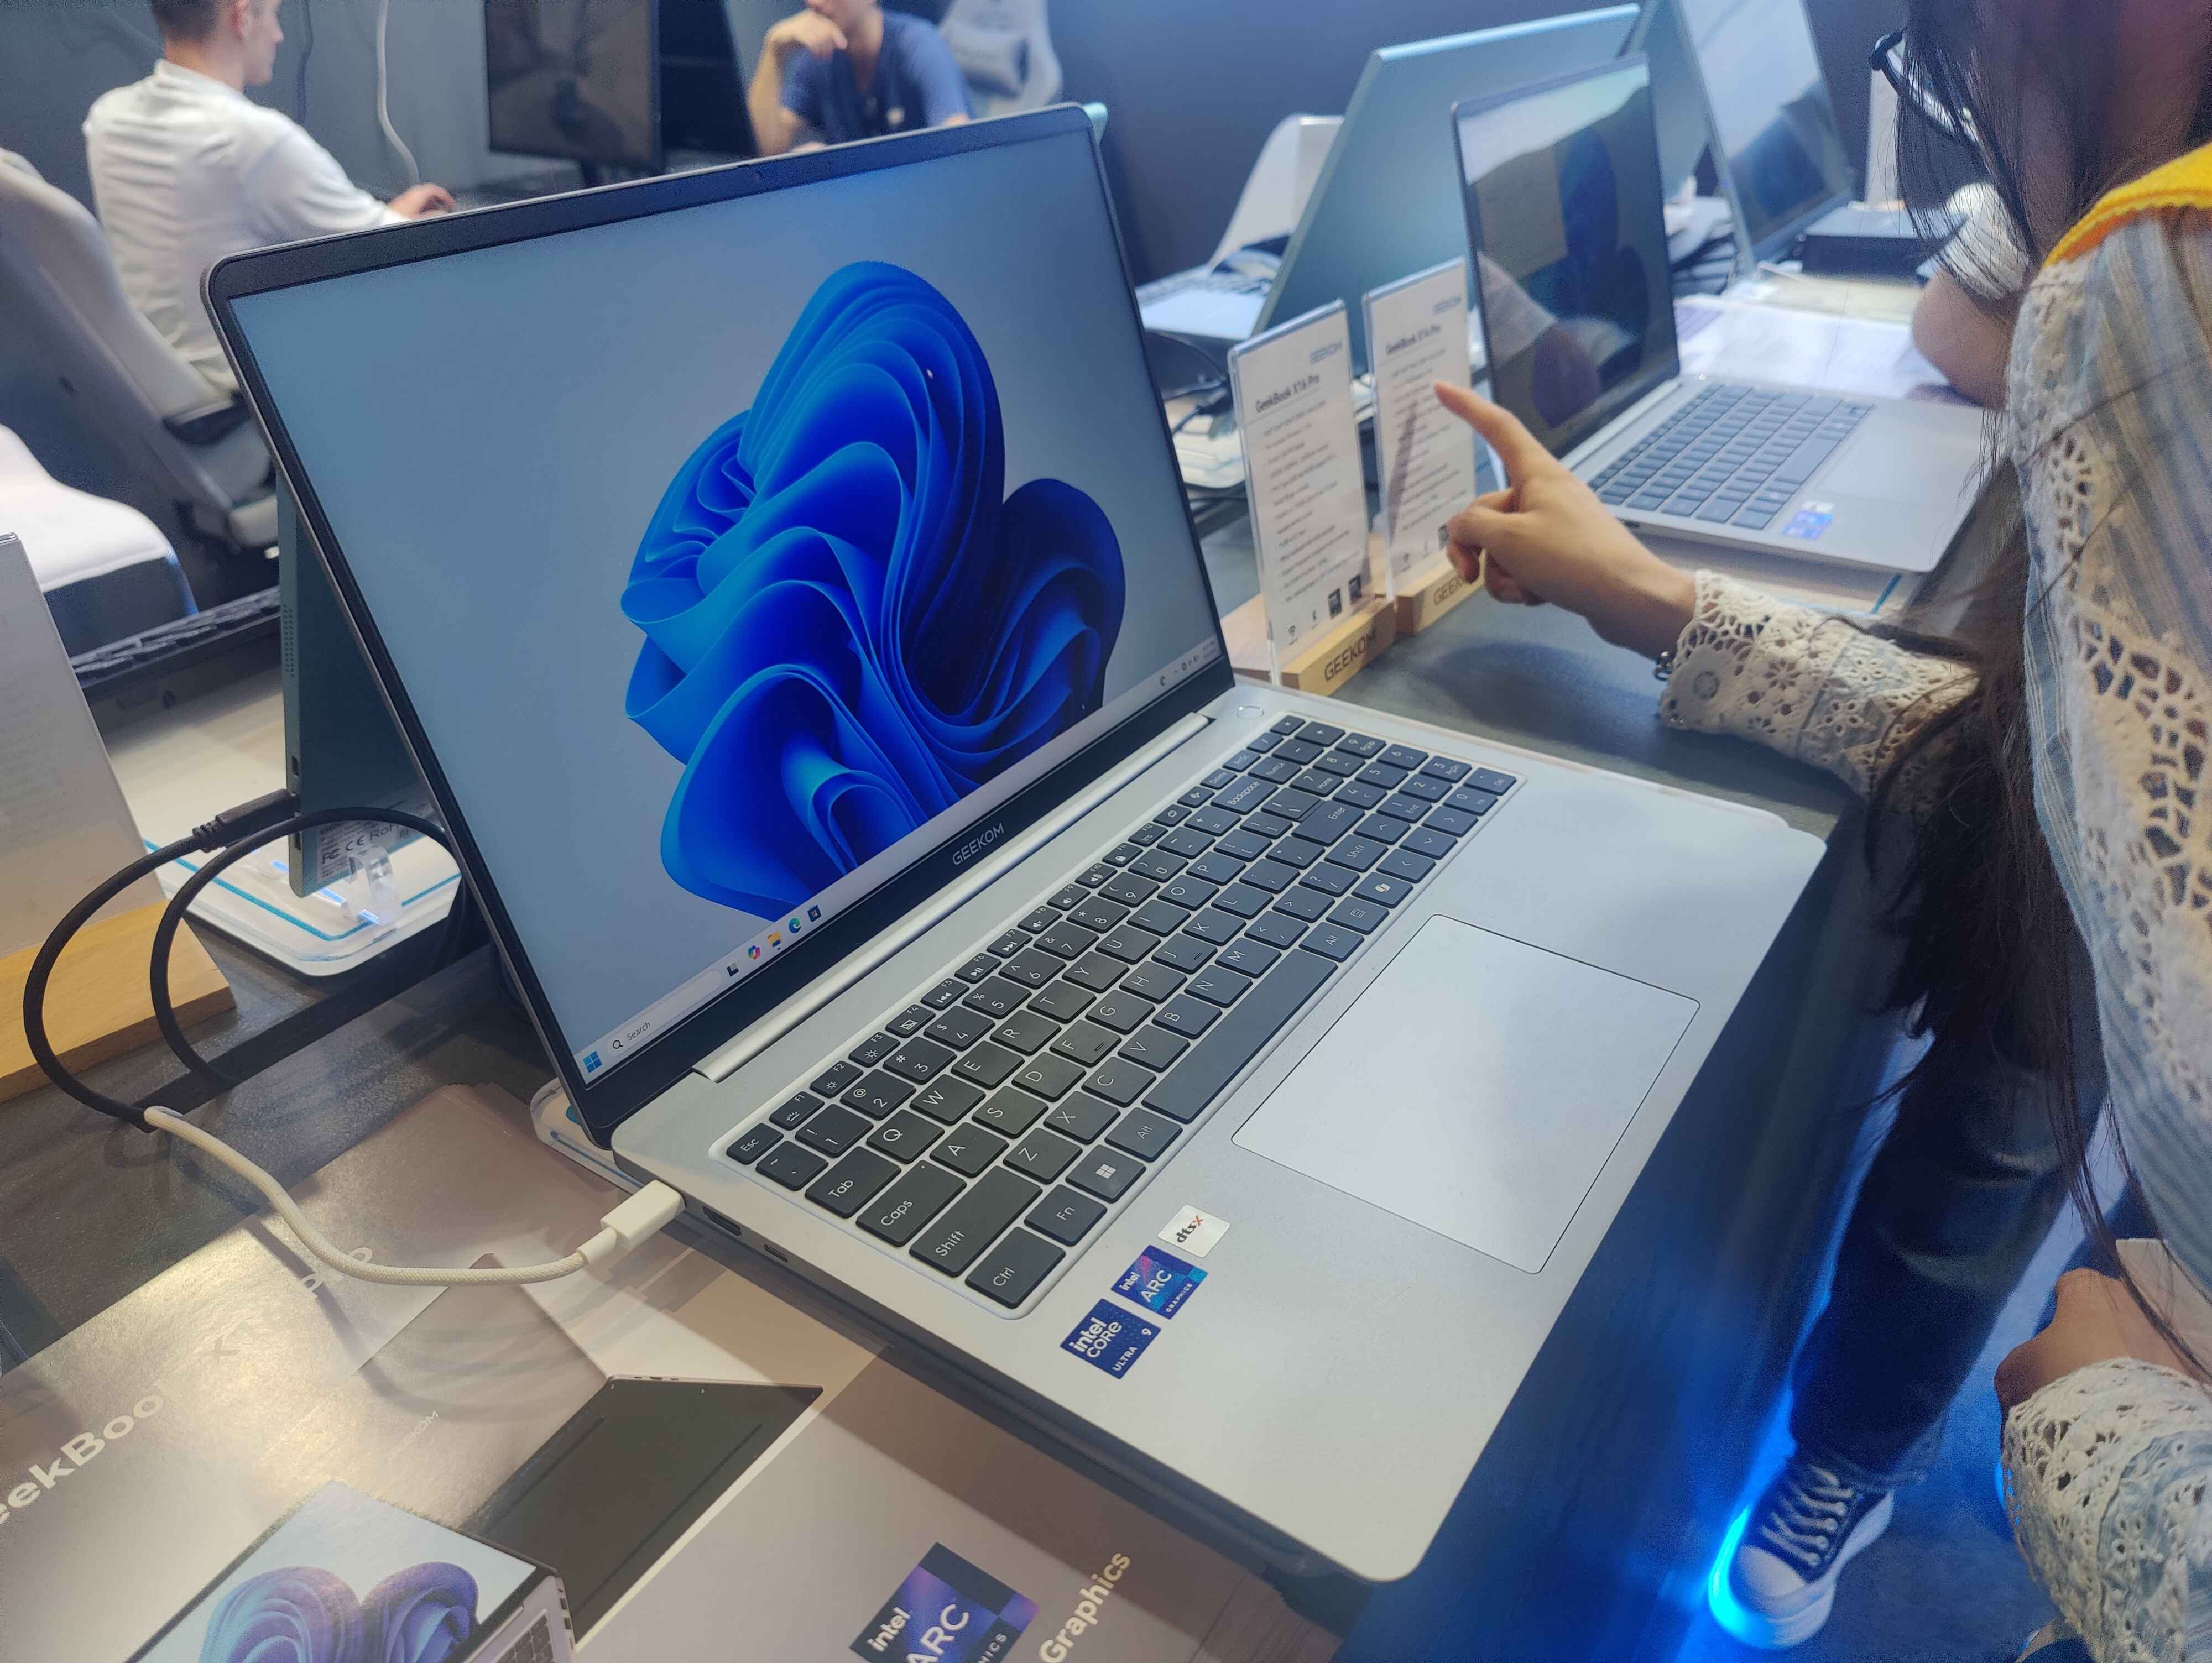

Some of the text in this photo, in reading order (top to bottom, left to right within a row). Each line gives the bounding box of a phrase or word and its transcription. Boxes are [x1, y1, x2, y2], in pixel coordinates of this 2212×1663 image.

[1433, 574, 1464, 605] GEEK
[1324, 629, 1377, 681] GEEKOM
[1316, 777, 1333, 789] Home
[1227, 781, 1260, 805] Backspace
[1328, 807, 1345, 820] Enter
[952, 822, 1005, 865] GEEKOM
[1347, 845, 1365, 859] Shift
[1091, 864, 1102, 872] F10
[1193, 922, 1210, 932] K
[1107, 939, 1123, 949] U
[1326, 935, 1339, 946] Alt
[1227, 950, 1246, 962] M
[1074, 966, 1089, 975] Y
[1131, 976, 1149, 987] H
[1196, 980, 1214, 991] N
[991, 1001, 1004, 1009] 5
[1040, 996, 1055, 1005] T
[1100, 1006, 1116, 1016] G
[1164, 1012, 1180, 1022] B
[627, 1021, 651, 1041] Search
[1002, 1029, 1020, 1039] R
[872, 1034, 883, 1042] F3
[1061, 1040, 1074, 1050] F
[1130, 1041, 1146, 1051] V
[833, 1063, 845, 1071] F2
[914, 1063, 928, 1073] 3
[963, 1060, 981, 1071] E
[1025, 1071, 1042, 1082] D
[1097, 1075, 1114, 1086] C
[873, 1098, 888, 1107] 2
[922, 1090, 944, 1105] W
[987, 1107, 1003, 1118] S
[1056, 1111, 1076, 1124] X
[883, 1129, 903, 1142] Q
[1136, 1125, 1152, 1139] Alt
[740, 1139, 759, 1152] Esc
[948, 1145, 966, 1157] A
[1018, 1147, 1038, 1162] Z
[828, 1180, 853, 1197] Tab
[881, 1200, 912, 1226] Caps
[1056, 1207, 1076, 1220] Fn
[935, 1231, 964, 1256] Shift
[993, 1267, 1015, 1286] Ctrl
[1119, 1272, 1140, 1291] intel
[1140, 1269, 1172, 1303] ARC
[1068, 1317, 1107, 1352] intel
[1141, 1328, 1152, 1336] 9
[1113, 1346, 1138, 1371] ULTRA
[1039, 1551, 1131, 1663] Graphics
[867, 1606, 911, 1652] intel
